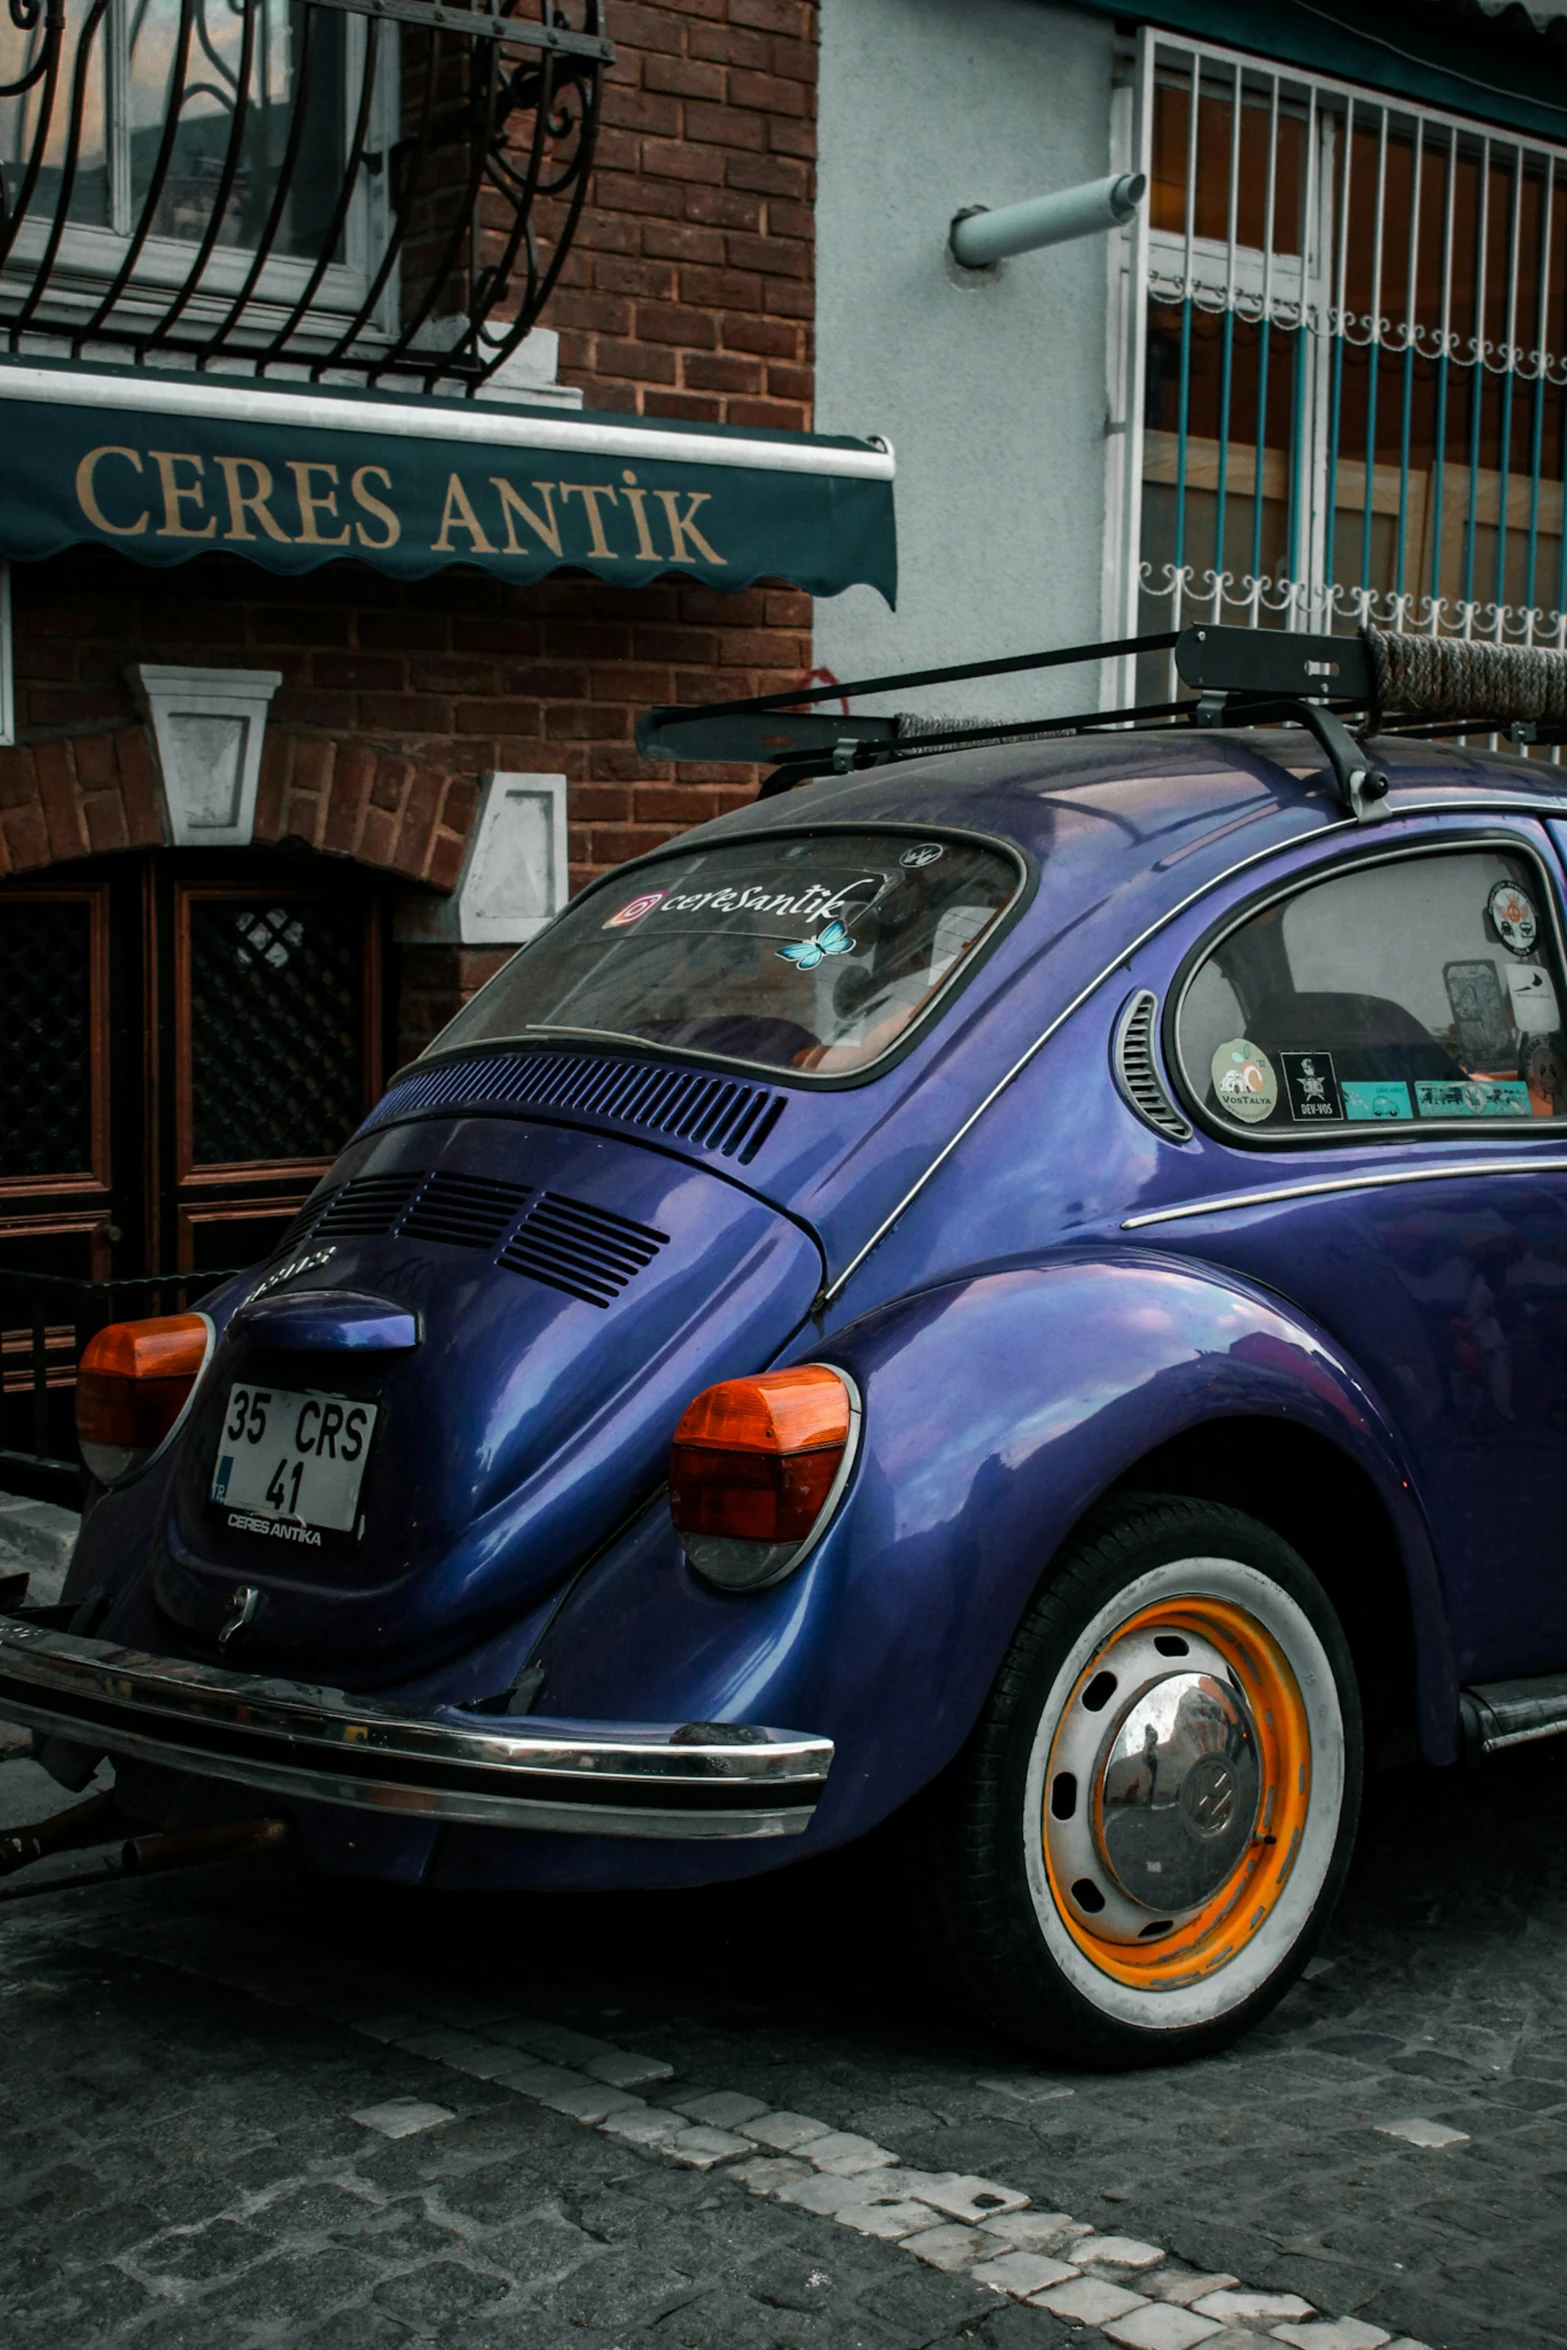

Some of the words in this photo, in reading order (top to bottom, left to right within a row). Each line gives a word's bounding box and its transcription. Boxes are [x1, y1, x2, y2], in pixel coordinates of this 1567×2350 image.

[75, 445, 402, 550] CERES
[430, 469, 729, 566] ANTİK
[227, 1390, 272, 1445] 35
[295, 1400, 368, 1462] CRS
[211, 1483, 225, 1500] TR
[265, 1458, 305, 1514] 41
[227, 1513, 271, 1536] CERES
